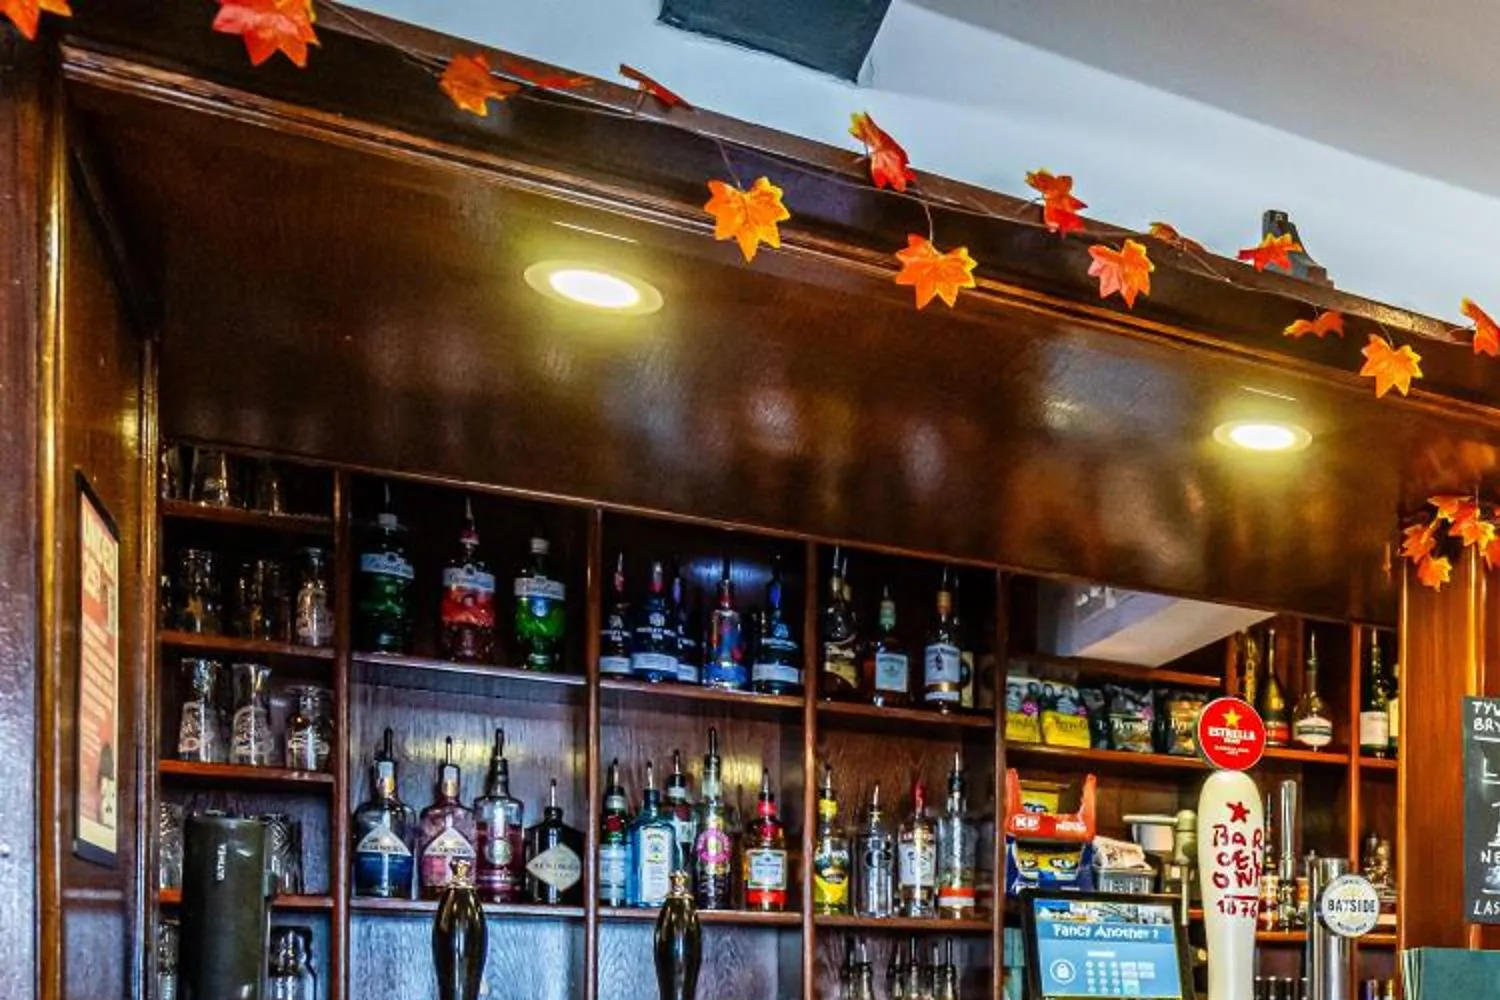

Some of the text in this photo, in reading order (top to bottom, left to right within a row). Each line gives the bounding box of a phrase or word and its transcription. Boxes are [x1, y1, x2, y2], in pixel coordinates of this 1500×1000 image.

[1208, 726, 1256, 741] ESTRELLA
[1015, 816, 1039, 828] KP
[1327, 899, 1376, 913] BAYSIDE
[1094, 926, 1150, 938] Another
